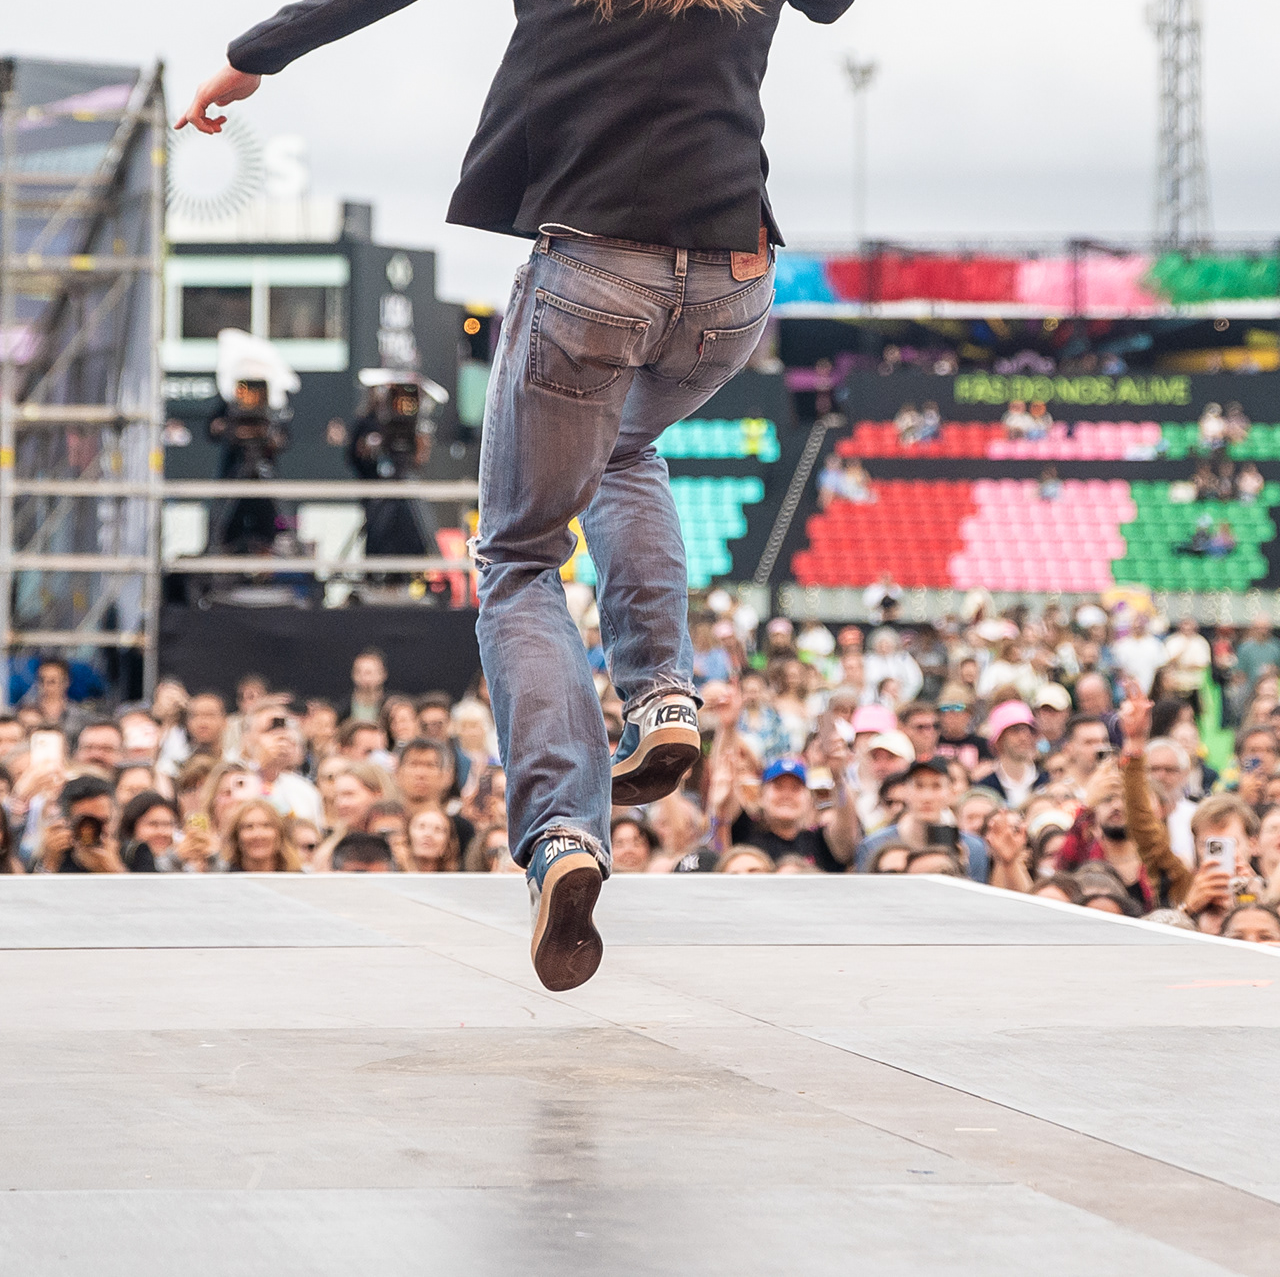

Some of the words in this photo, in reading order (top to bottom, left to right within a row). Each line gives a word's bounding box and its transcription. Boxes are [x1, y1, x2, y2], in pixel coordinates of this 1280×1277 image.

[1055, 375, 1115, 405] NOS
[1116, 375, 1192, 405] ALIVE
[655, 704, 697, 727] KERS
